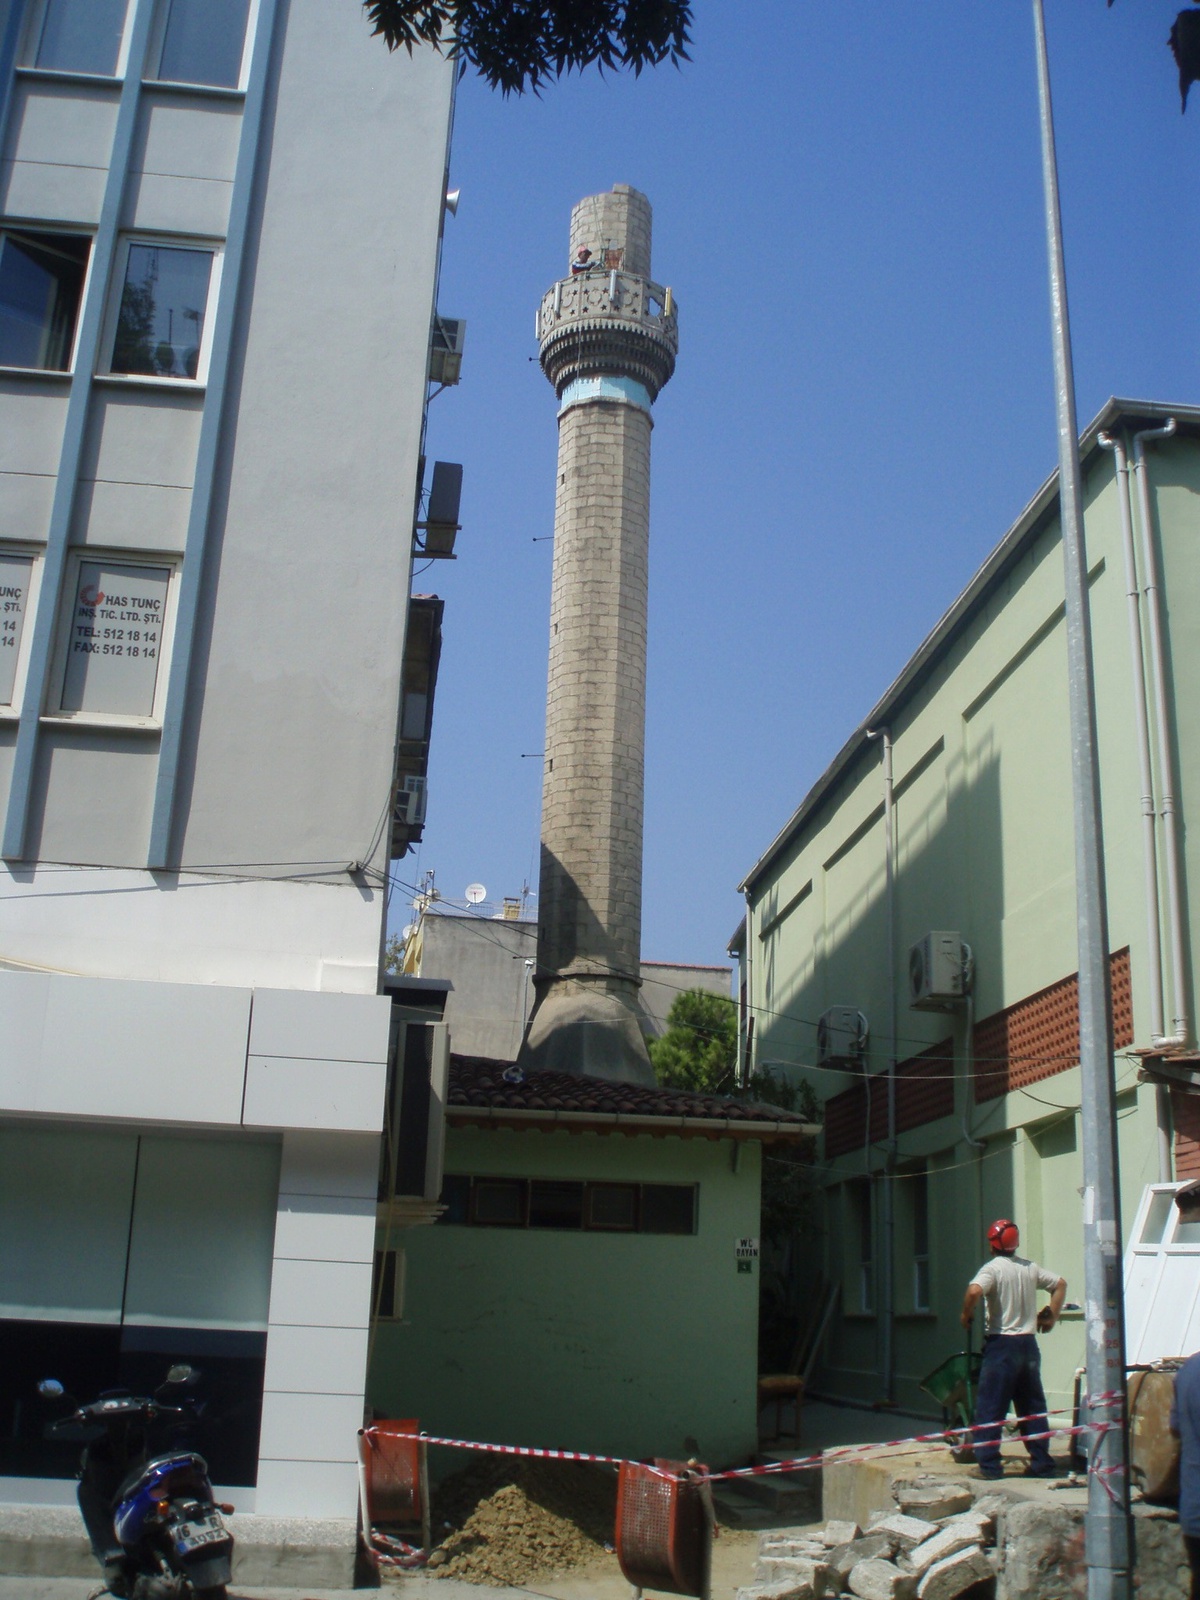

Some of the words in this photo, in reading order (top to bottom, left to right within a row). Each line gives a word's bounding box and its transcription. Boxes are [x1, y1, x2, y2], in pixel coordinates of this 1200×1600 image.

[0, 586, 22, 600] UNÇ
[106, 595, 128, 607] HAS
[131, 598, 160, 612] TUNÇ
[120, 611, 140, 622] LTD.
[3, 620, 16, 631] 14
[77, 626, 100, 638] TEL:
[104, 628, 124, 640] 512
[127, 630, 140, 641] 18
[144, 632, 156, 642] 14
[2, 636, 14, 647] 14
[74, 642, 100, 654] FAX:
[102, 644, 123, 656] 512
[126, 646, 139, 657] 18
[143, 647, 155, 658] 14
[740, 1239, 753, 1247] WC
[736, 1248, 758, 1257] BAYAN
